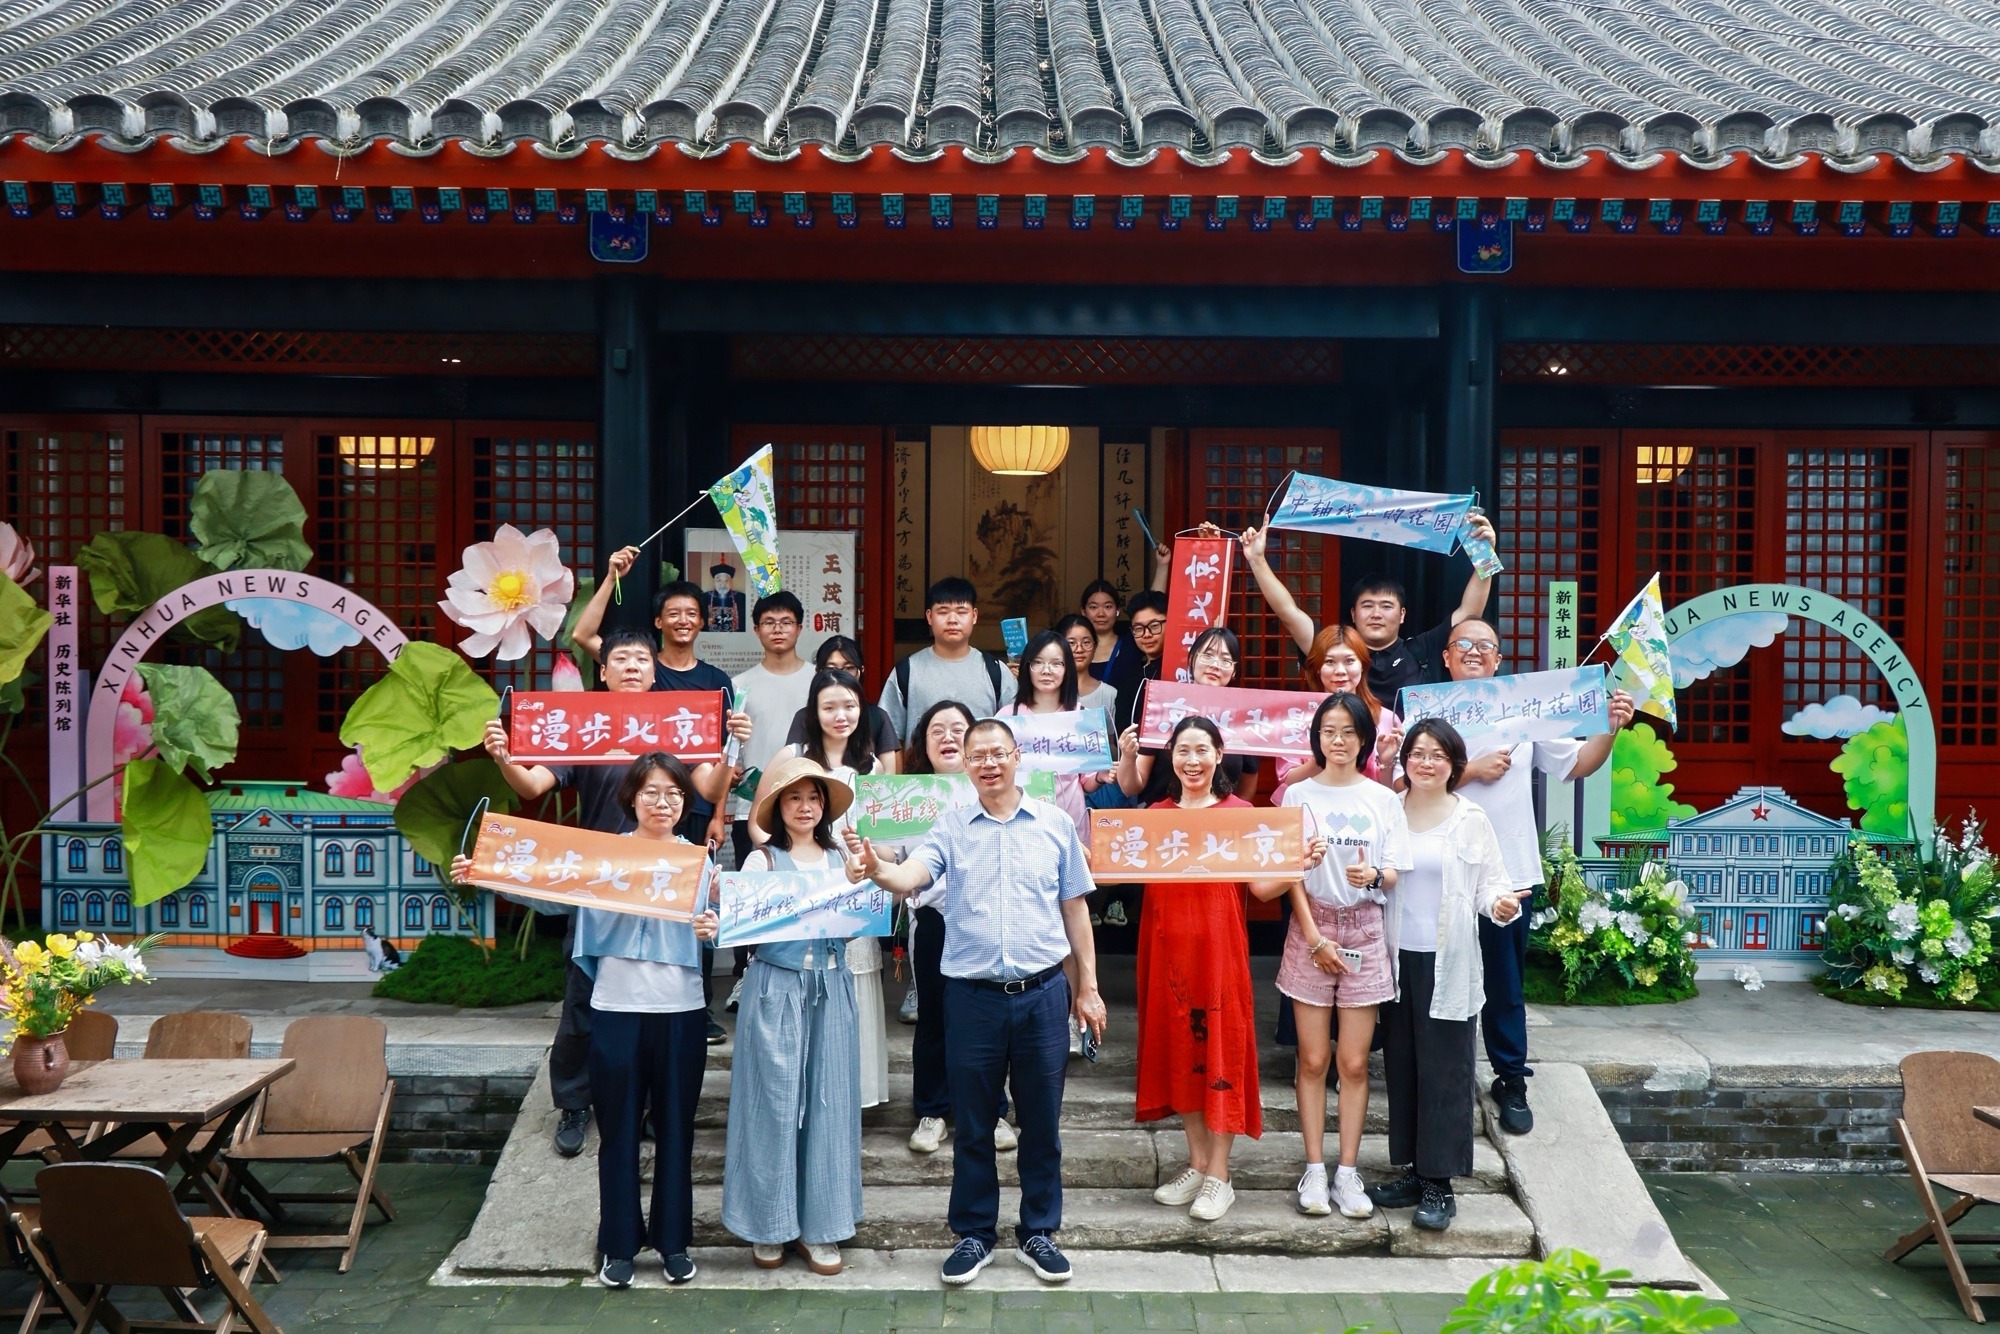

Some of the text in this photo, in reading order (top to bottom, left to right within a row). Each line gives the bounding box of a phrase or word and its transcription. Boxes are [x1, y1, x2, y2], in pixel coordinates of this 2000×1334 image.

[1291, 494, 1455, 535] 中轴线上的花园
[822, 553, 842, 633] 王茂荫
[1555, 590, 1572, 640] 新华社
[54, 575, 72, 732] 新华社 历史陈列馆
[101, 575, 404, 694] XINHUA NEWS AGEN
[1723, 590, 1812, 612] NEWS
[1831, 610, 1922, 710] AGENCY
[530, 706, 704, 751] 漫步北京
[1413, 689, 1598, 727] 中轴线上的花园
[1110, 823, 1285, 868] 漫步北京
[1327, 835, 1335, 845] is
[1336, 837, 1342, 845] a
[493, 838, 683, 902] 漫步北京
[728, 889, 887, 926] 中轴线上的花园
